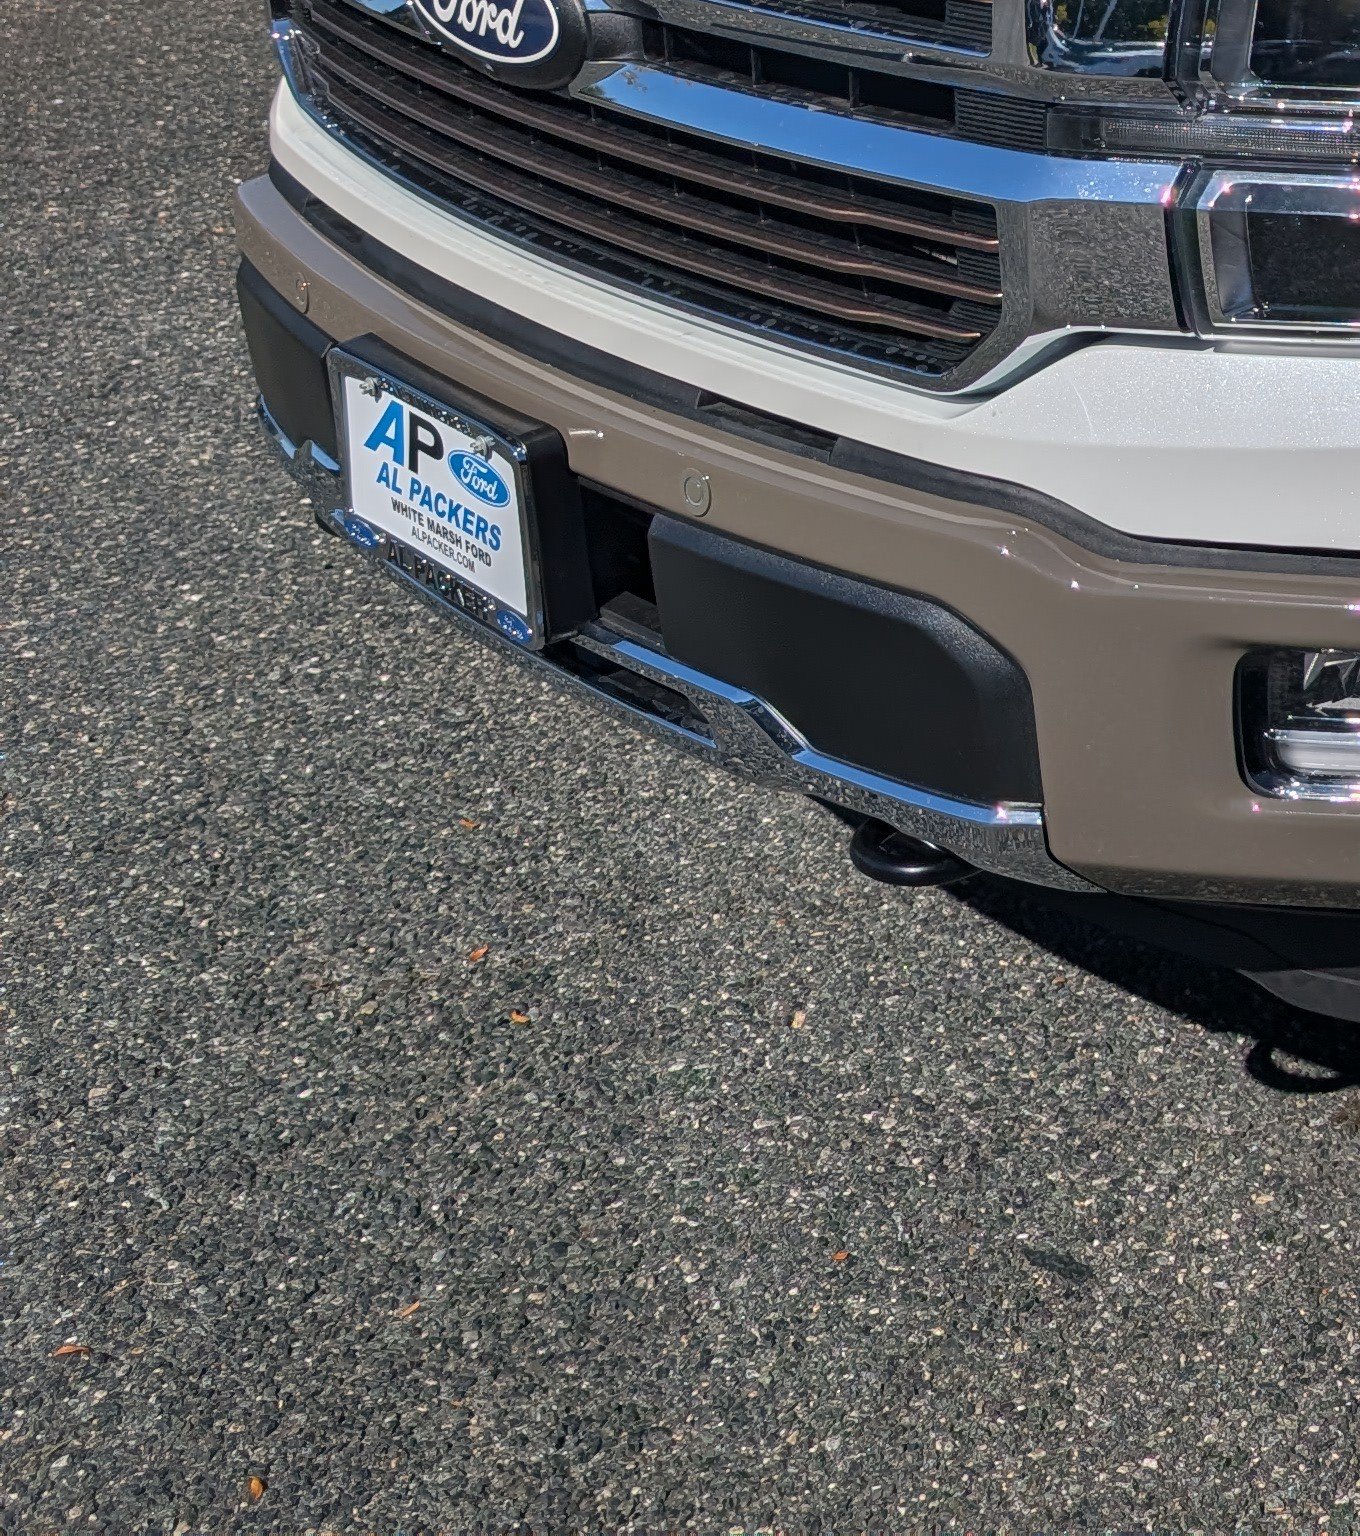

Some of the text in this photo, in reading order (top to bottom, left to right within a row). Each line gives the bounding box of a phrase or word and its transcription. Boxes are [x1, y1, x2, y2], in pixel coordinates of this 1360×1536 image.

[364, 399, 444, 475] AP
[376, 461, 403, 495] AL
[409, 477, 502, 552] PACKERS
[460, 456, 499, 501] Ford
[391, 496, 492, 567] WHITE MARSH FORD
[411, 525, 476, 573] ALPACKER.COM
